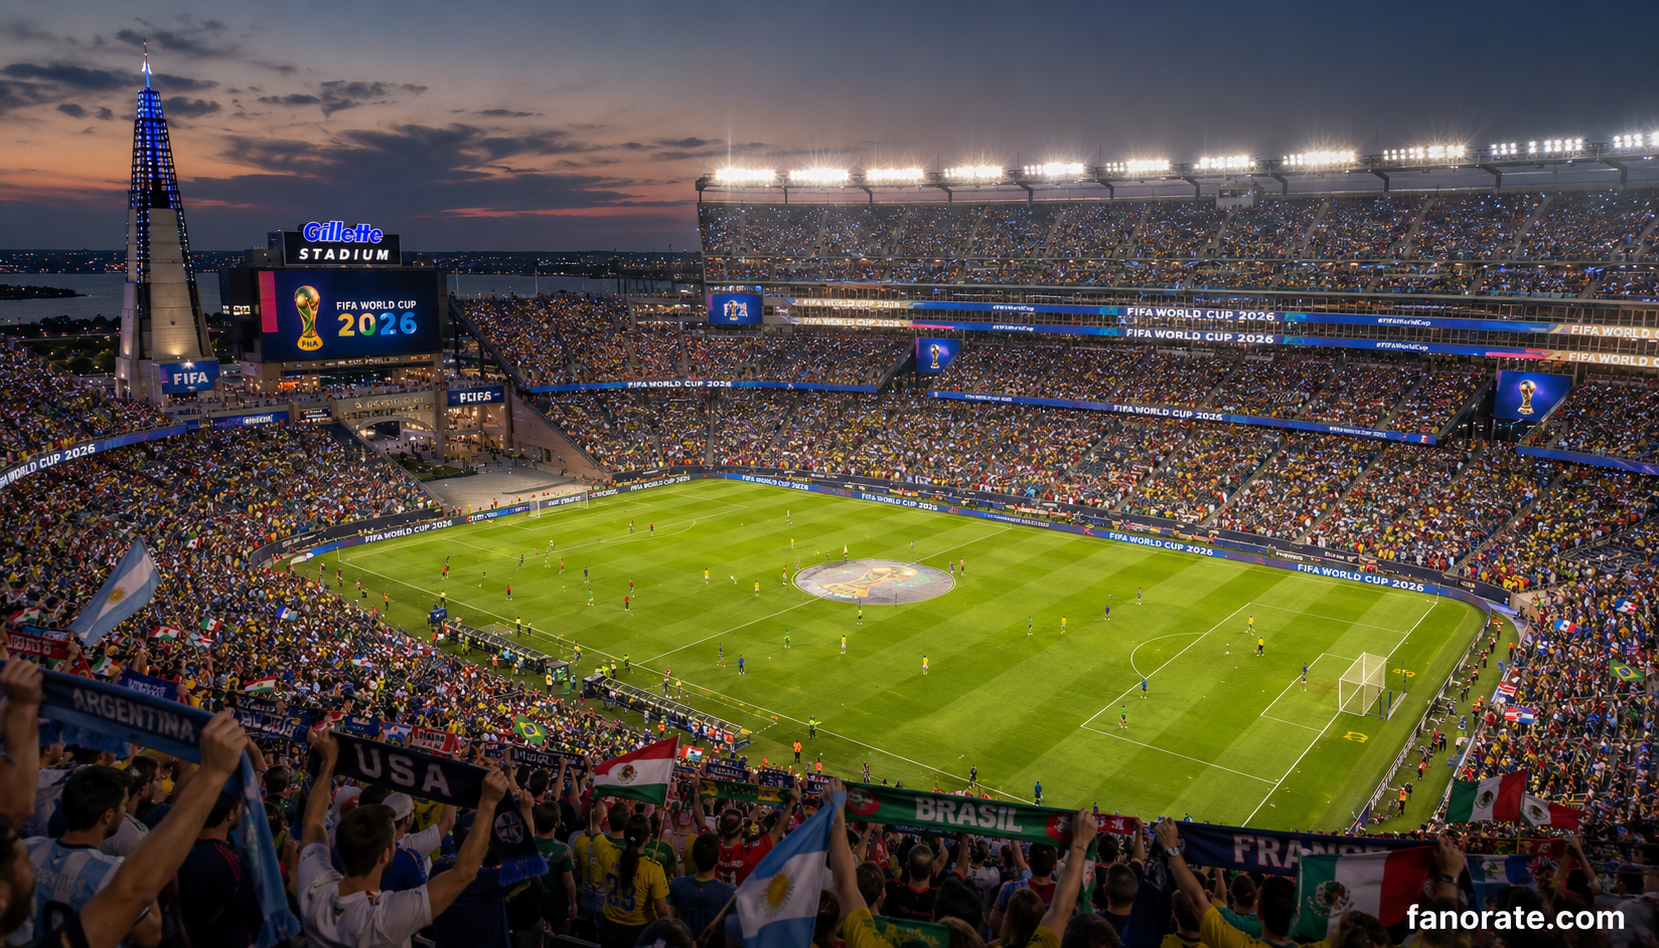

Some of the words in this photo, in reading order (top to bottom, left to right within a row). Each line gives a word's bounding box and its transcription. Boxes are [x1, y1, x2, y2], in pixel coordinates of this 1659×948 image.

[303, 220, 383, 243] Gillette
[299, 248, 389, 261] STADIUM
[336, 301, 358, 311] FIFA
[360, 301, 395, 310] WORLD
[398, 300, 417, 309] CUP
[1126, 307, 1153, 317] FIFA
[1155, 308, 1201, 319] WORLD
[1206, 310, 1234, 320] CUP
[1238, 311, 1275, 321] 2026
[337, 312, 418, 337] 2026
[1570, 325, 1600, 335] FIFA
[1601, 326, 1650, 339] WORLD
[1126, 328, 1152, 338] FIFA
[1154, 330, 1201, 341] WORLD
[1205, 332, 1233, 342] CUP
[1237, 333, 1274, 344] 2026
[1568, 352, 1597, 363] FIFA
[1598, 353, 1648, 367] WORLD
[173, 372, 208, 385] FIFA
[1113, 404, 1135, 413] FIFA
[1135, 406, 1169, 416] WORLD
[1172, 410, 1193, 418] CUP
[1195, 412, 1223, 421] 2026
[7, 462, 38, 482] WORLD
[39, 453, 61, 469] CUP
[64, 443, 95, 460] 2026
[902, 498, 917, 507] CUP
[414, 523, 430, 533] CUP
[1108, 532, 1128, 542] FIFA
[1129, 536, 1162, 548] WORLD
[1164, 542, 1184, 551] CUP
[1186, 545, 1214, 556] 2026
[1297, 563, 1320, 575] FIFA
[1321, 566, 1362, 581] WORLD
[1365, 575, 1389, 586] CUP
[1391, 579, 1425, 593] 2026
[71, 687, 196, 744] ARGENTINA
[353, 742, 452, 798] USA
[915, 795, 1023, 834] BRASIL
[1232, 832, 1388, 869] FRA
